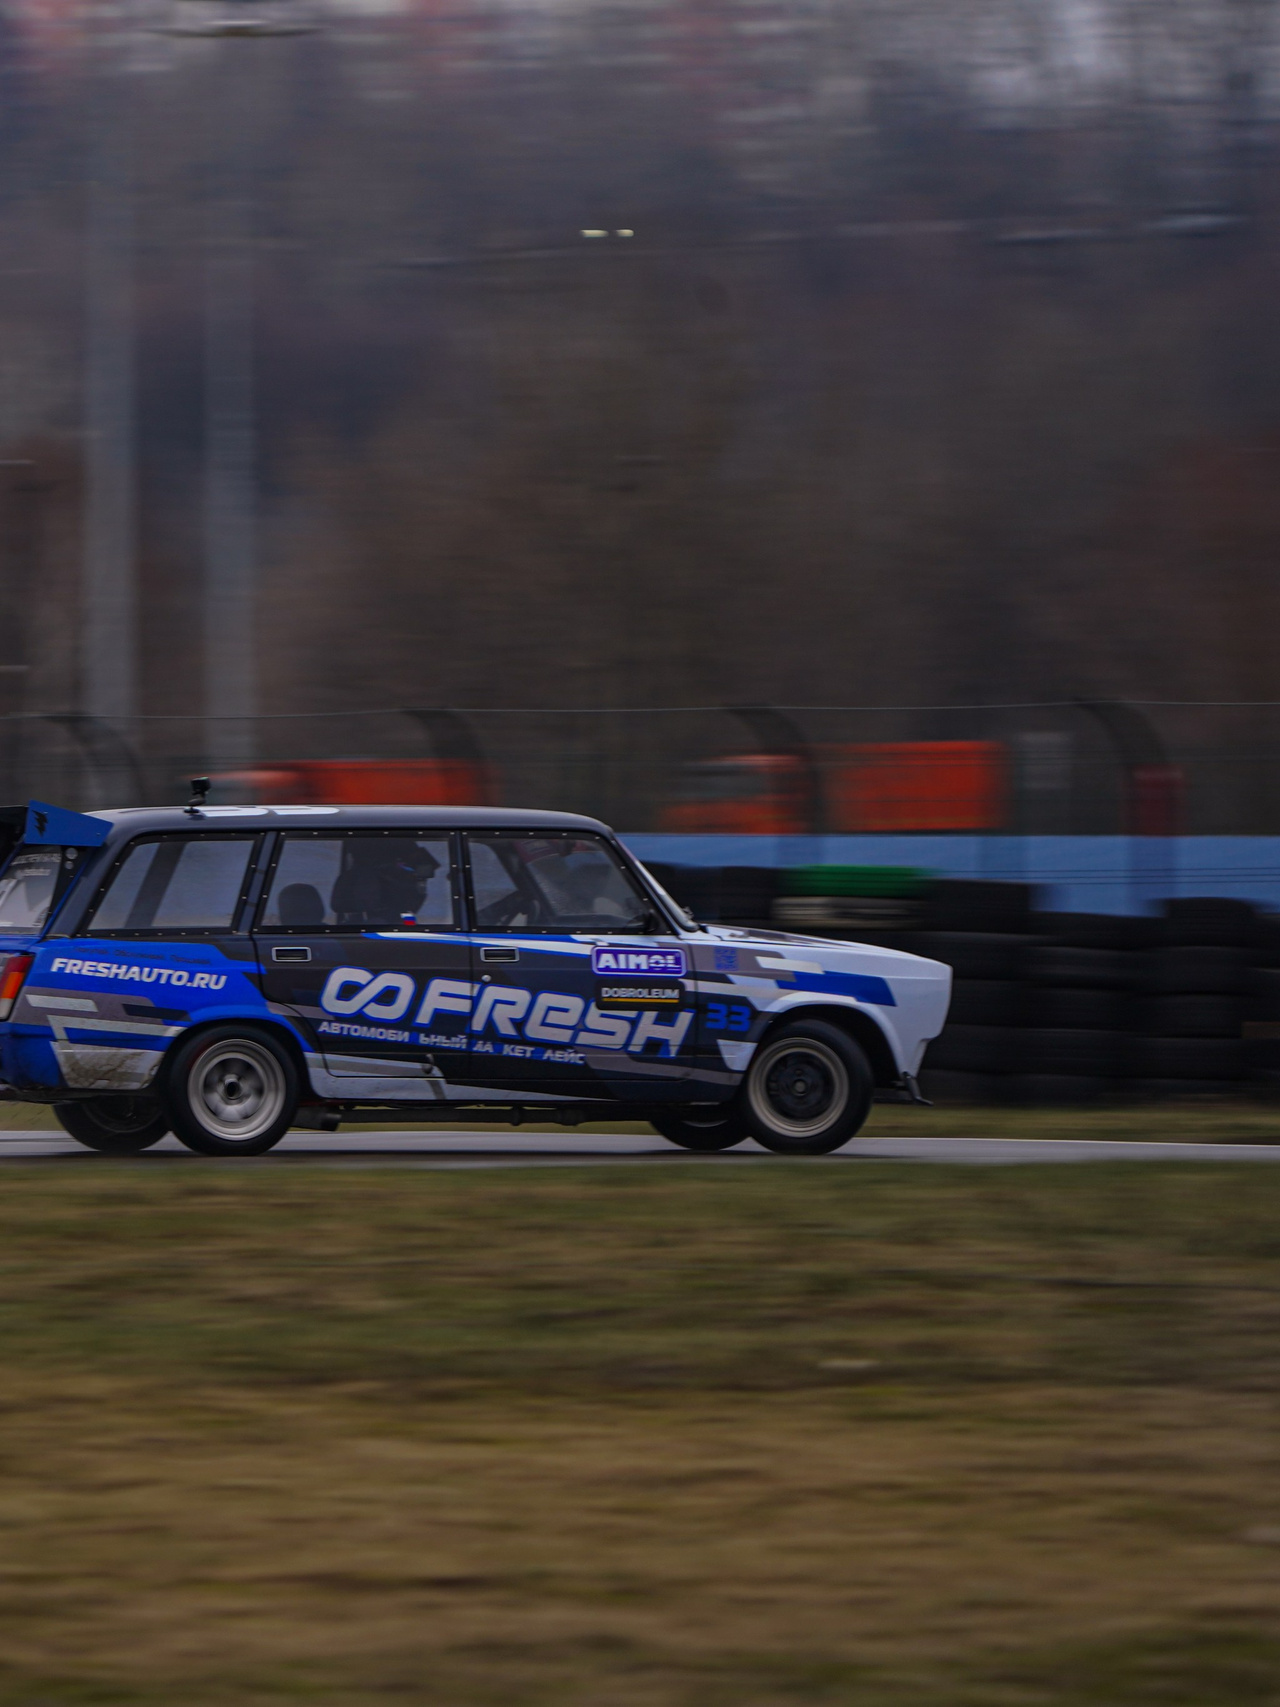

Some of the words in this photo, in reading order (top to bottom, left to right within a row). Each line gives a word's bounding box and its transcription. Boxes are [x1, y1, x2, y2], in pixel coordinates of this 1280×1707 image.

[50, 957, 228, 990] FRESHAUTO.RU
[597, 952, 682, 971] AIMOL
[601, 986, 681, 999] DOBROLEUM
[705, 1002, 751, 1032] 33
